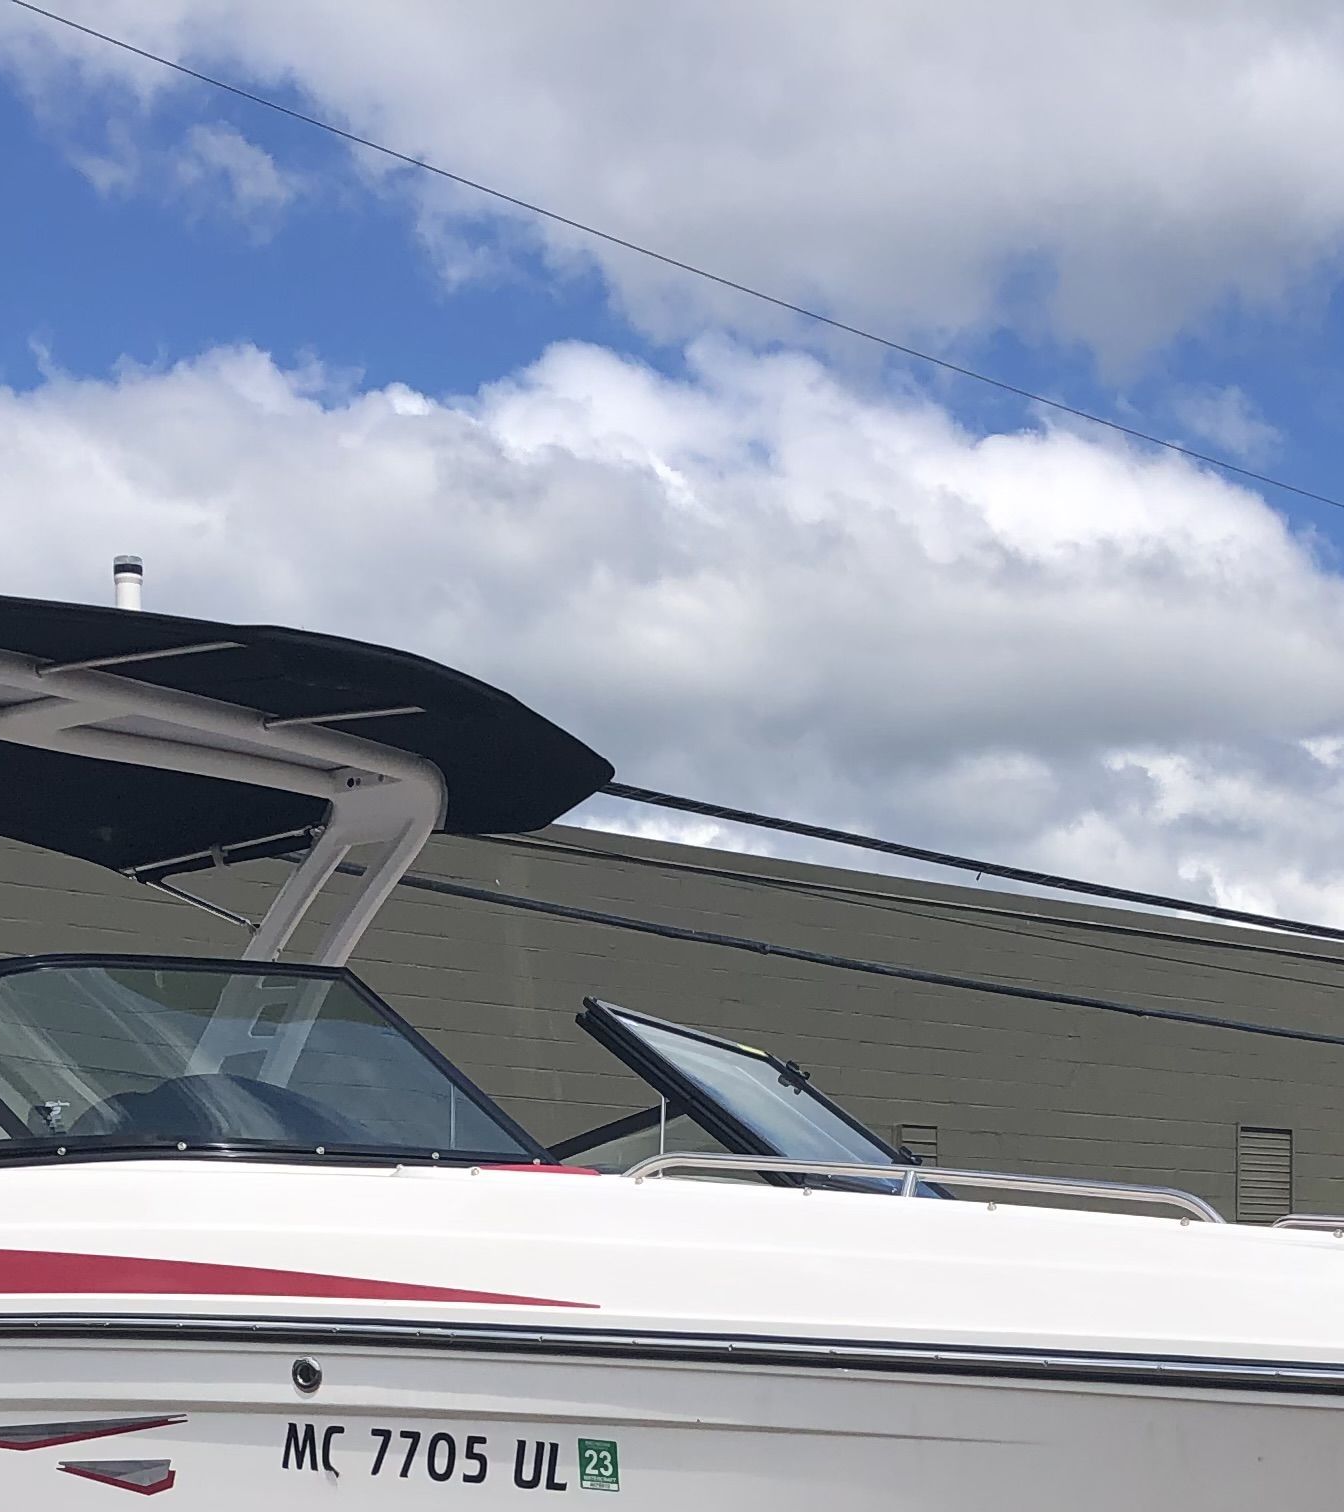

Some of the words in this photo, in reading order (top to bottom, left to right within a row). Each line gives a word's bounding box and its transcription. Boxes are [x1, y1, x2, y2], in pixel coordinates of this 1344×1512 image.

[282, 1422, 345, 1478] MC
[371, 1428, 488, 1484] 7705
[514, 1439, 568, 1491] UL
[584, 1449, 614, 1477] 23
